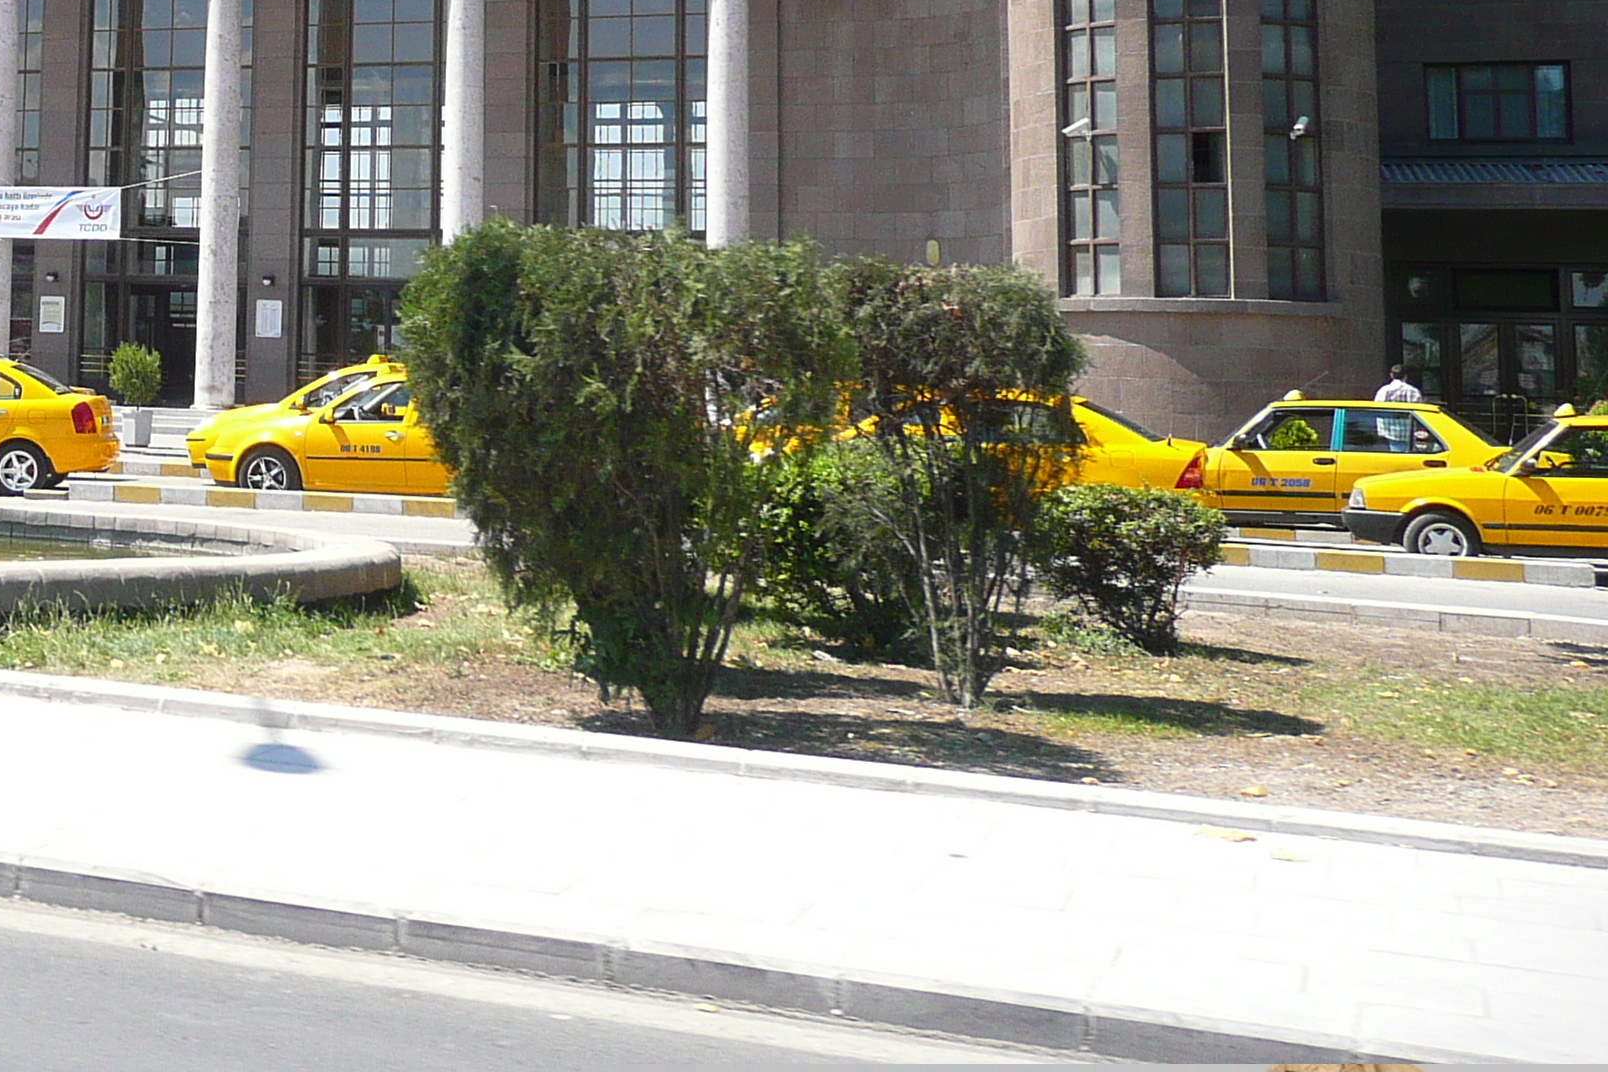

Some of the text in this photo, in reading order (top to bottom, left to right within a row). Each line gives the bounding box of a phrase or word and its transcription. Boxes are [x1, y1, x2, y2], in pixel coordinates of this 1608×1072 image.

[78, 223, 108, 232] TCDD
[1252, 477, 1267, 486] 06
[1269, 477, 1278, 487] T
[1534, 504, 1555, 515] 06
[1559, 505, 1572, 515] T
